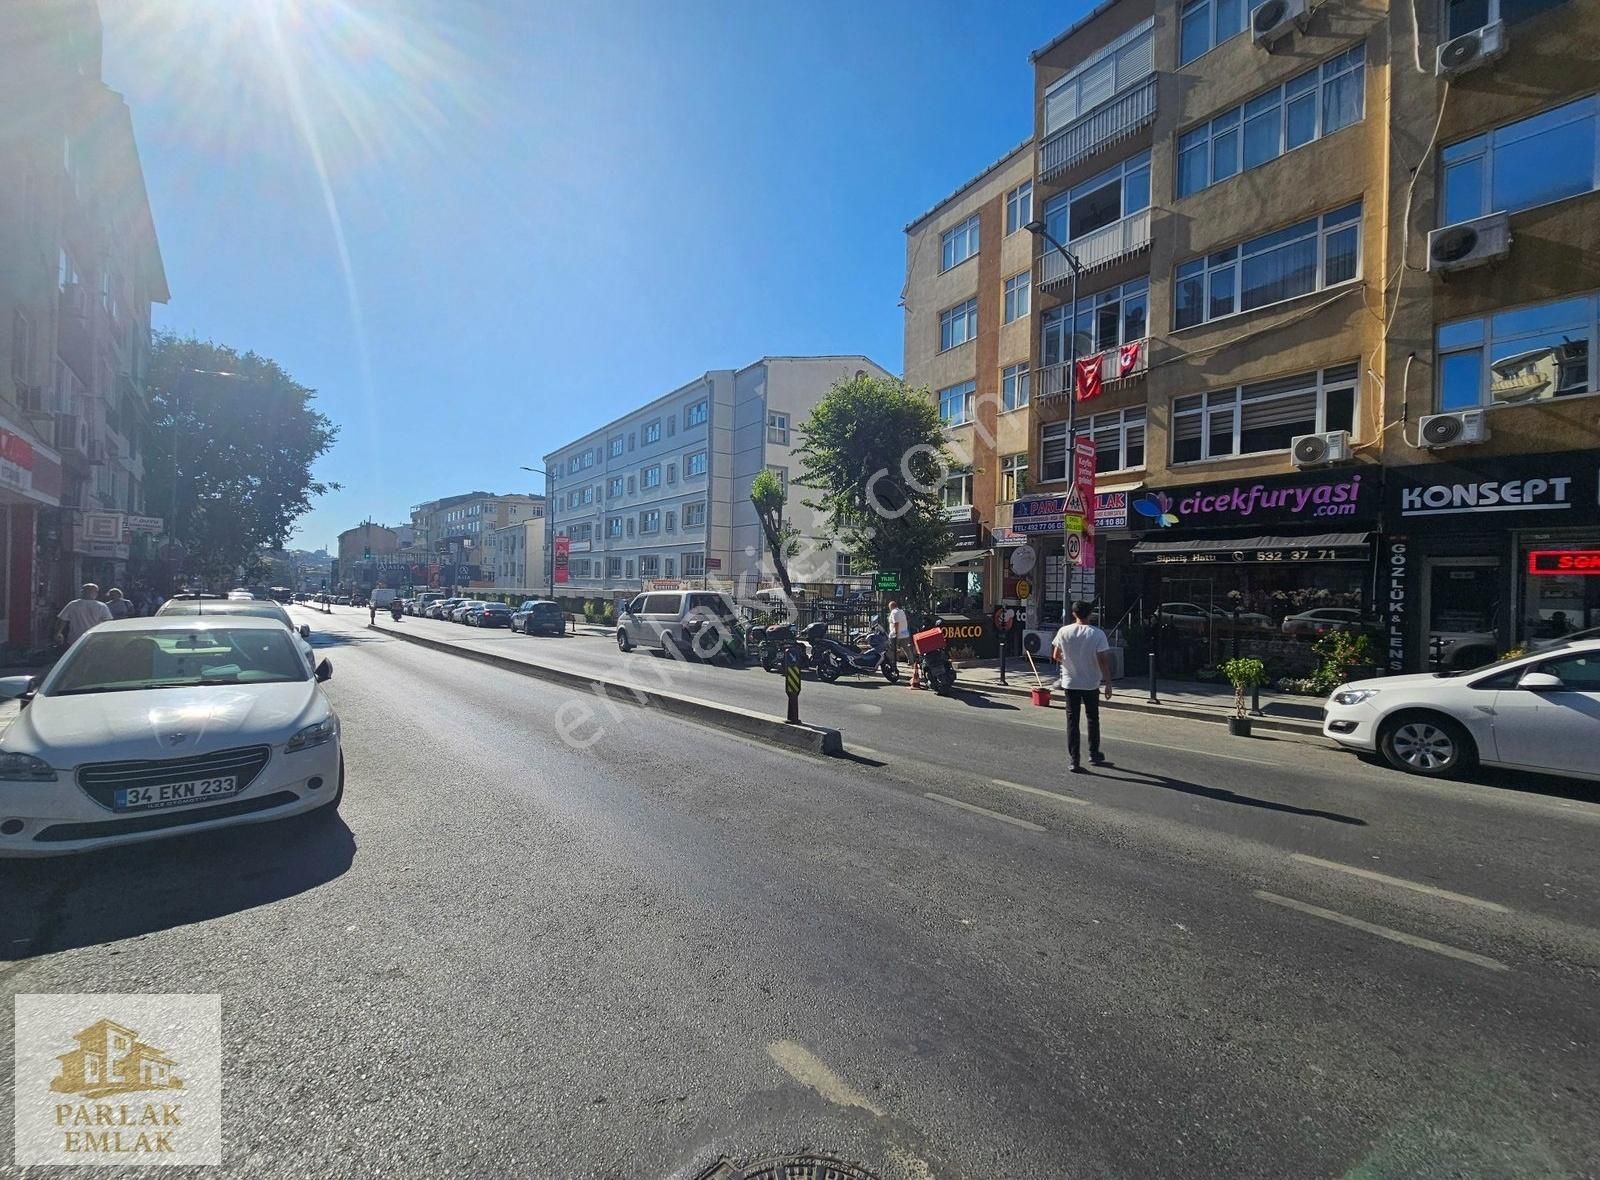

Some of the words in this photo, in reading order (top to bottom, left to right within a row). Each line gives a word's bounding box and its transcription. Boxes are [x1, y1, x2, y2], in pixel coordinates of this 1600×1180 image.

[1179, 474, 1362, 516] cicekfuryasi
[1402, 477, 1571, 509] KONSEPT
[1313, 503, 1356, 517] .com
[1070, 540, 1078, 553] 20
[1257, 551, 1282, 561] 532
[1291, 551, 1308, 560] 37
[1318, 550, 1336, 559] 71
[942, 626, 982, 638] OBACCO
[127, 790, 153, 806] 34
[159, 783, 195, 801] EKN
[200, 778, 234, 795] 233
